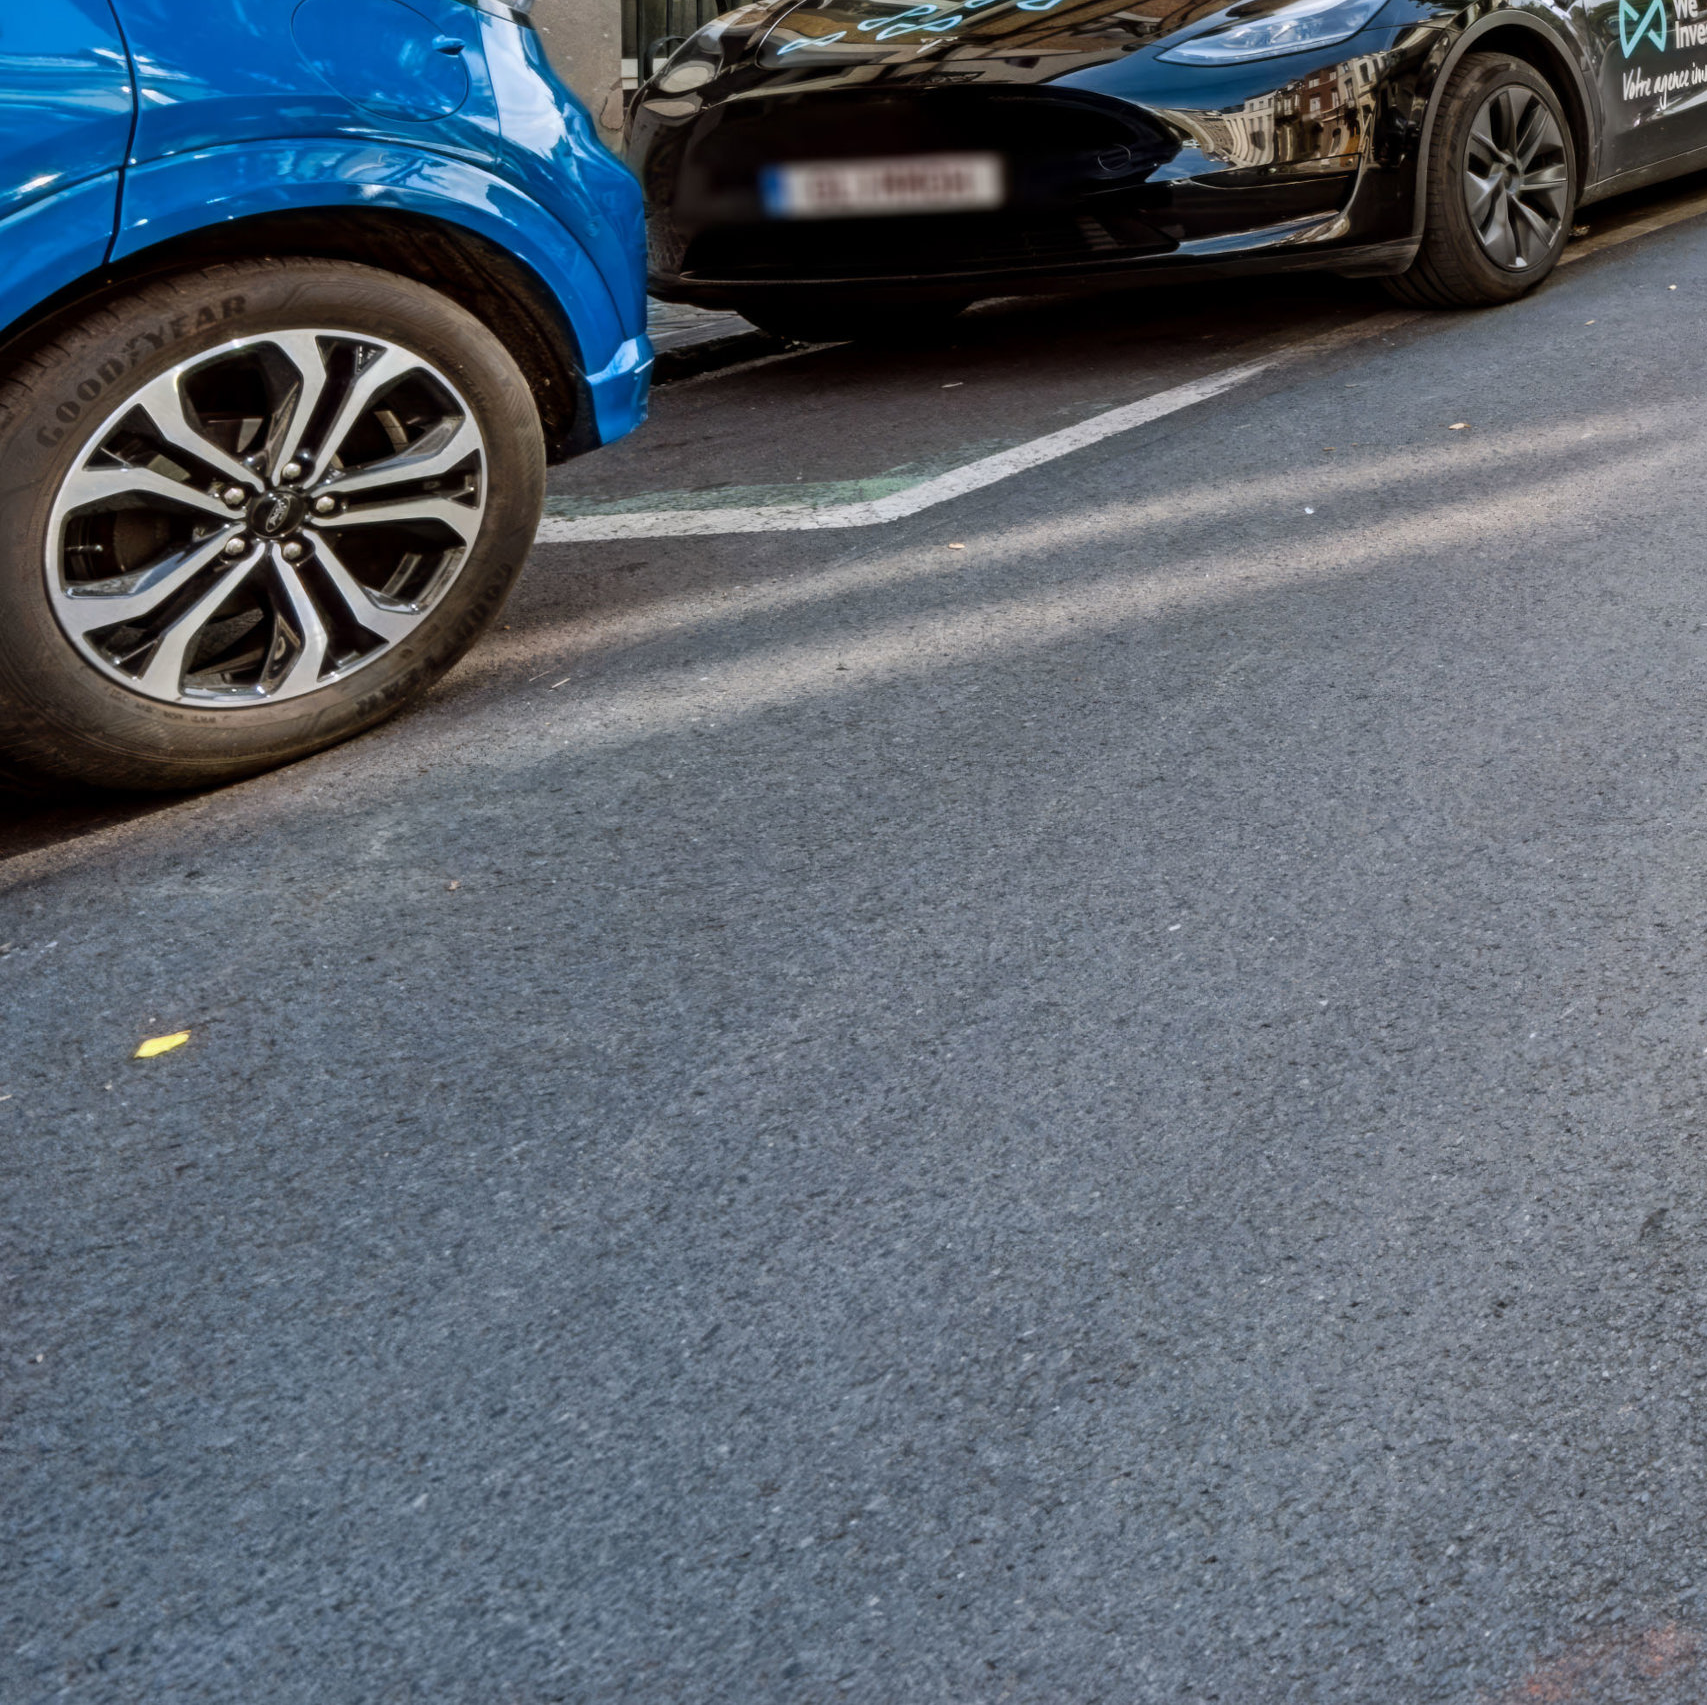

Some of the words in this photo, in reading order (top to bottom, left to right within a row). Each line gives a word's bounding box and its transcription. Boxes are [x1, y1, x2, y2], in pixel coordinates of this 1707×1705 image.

[1623, 66, 1651, 101] Votre
[1653, 70, 1690, 110] agence
[35, 294, 248, 448] GOODYEAR
